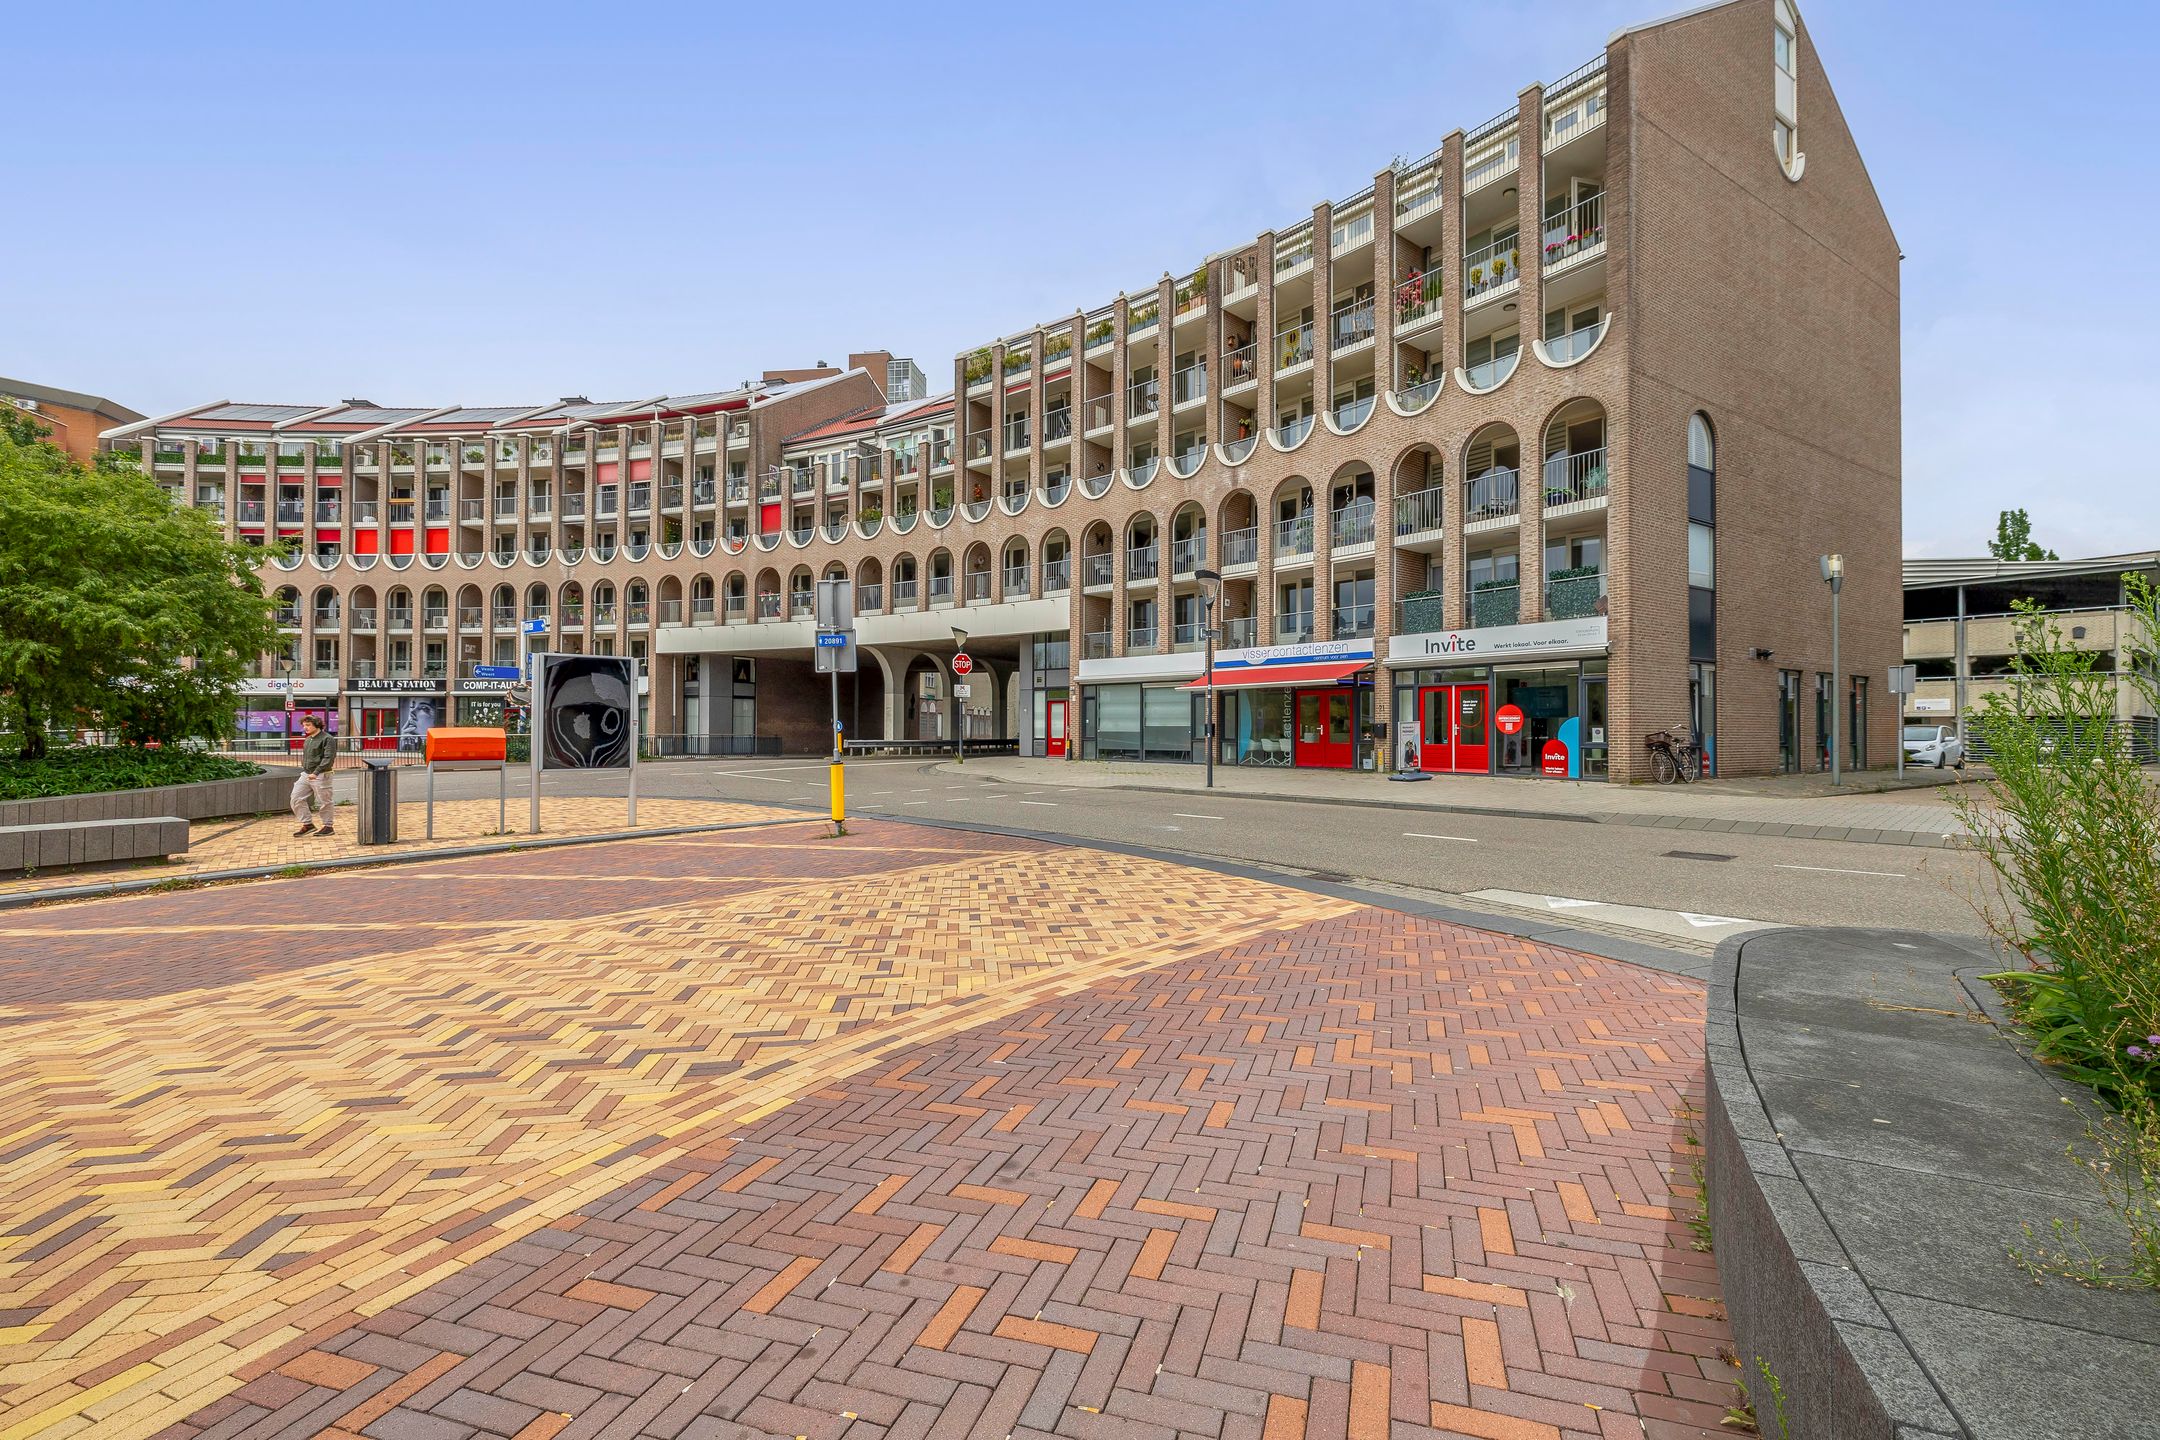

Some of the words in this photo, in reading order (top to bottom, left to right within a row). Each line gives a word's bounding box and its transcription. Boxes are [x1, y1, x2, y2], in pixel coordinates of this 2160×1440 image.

[824, 637, 842, 645] 20891
[1425, 634, 1476, 654] Invite
[1512, 640, 1532, 648] lokaal.
[1242, 648, 1272, 659] visser
[1273, 642, 1349, 658] contactlenzen
[954, 660, 971, 669] STOP
[358, 680, 395, 688] BEAUTY
[396, 680, 436, 688] STATION
[1544, 752, 1565, 761] Invite
